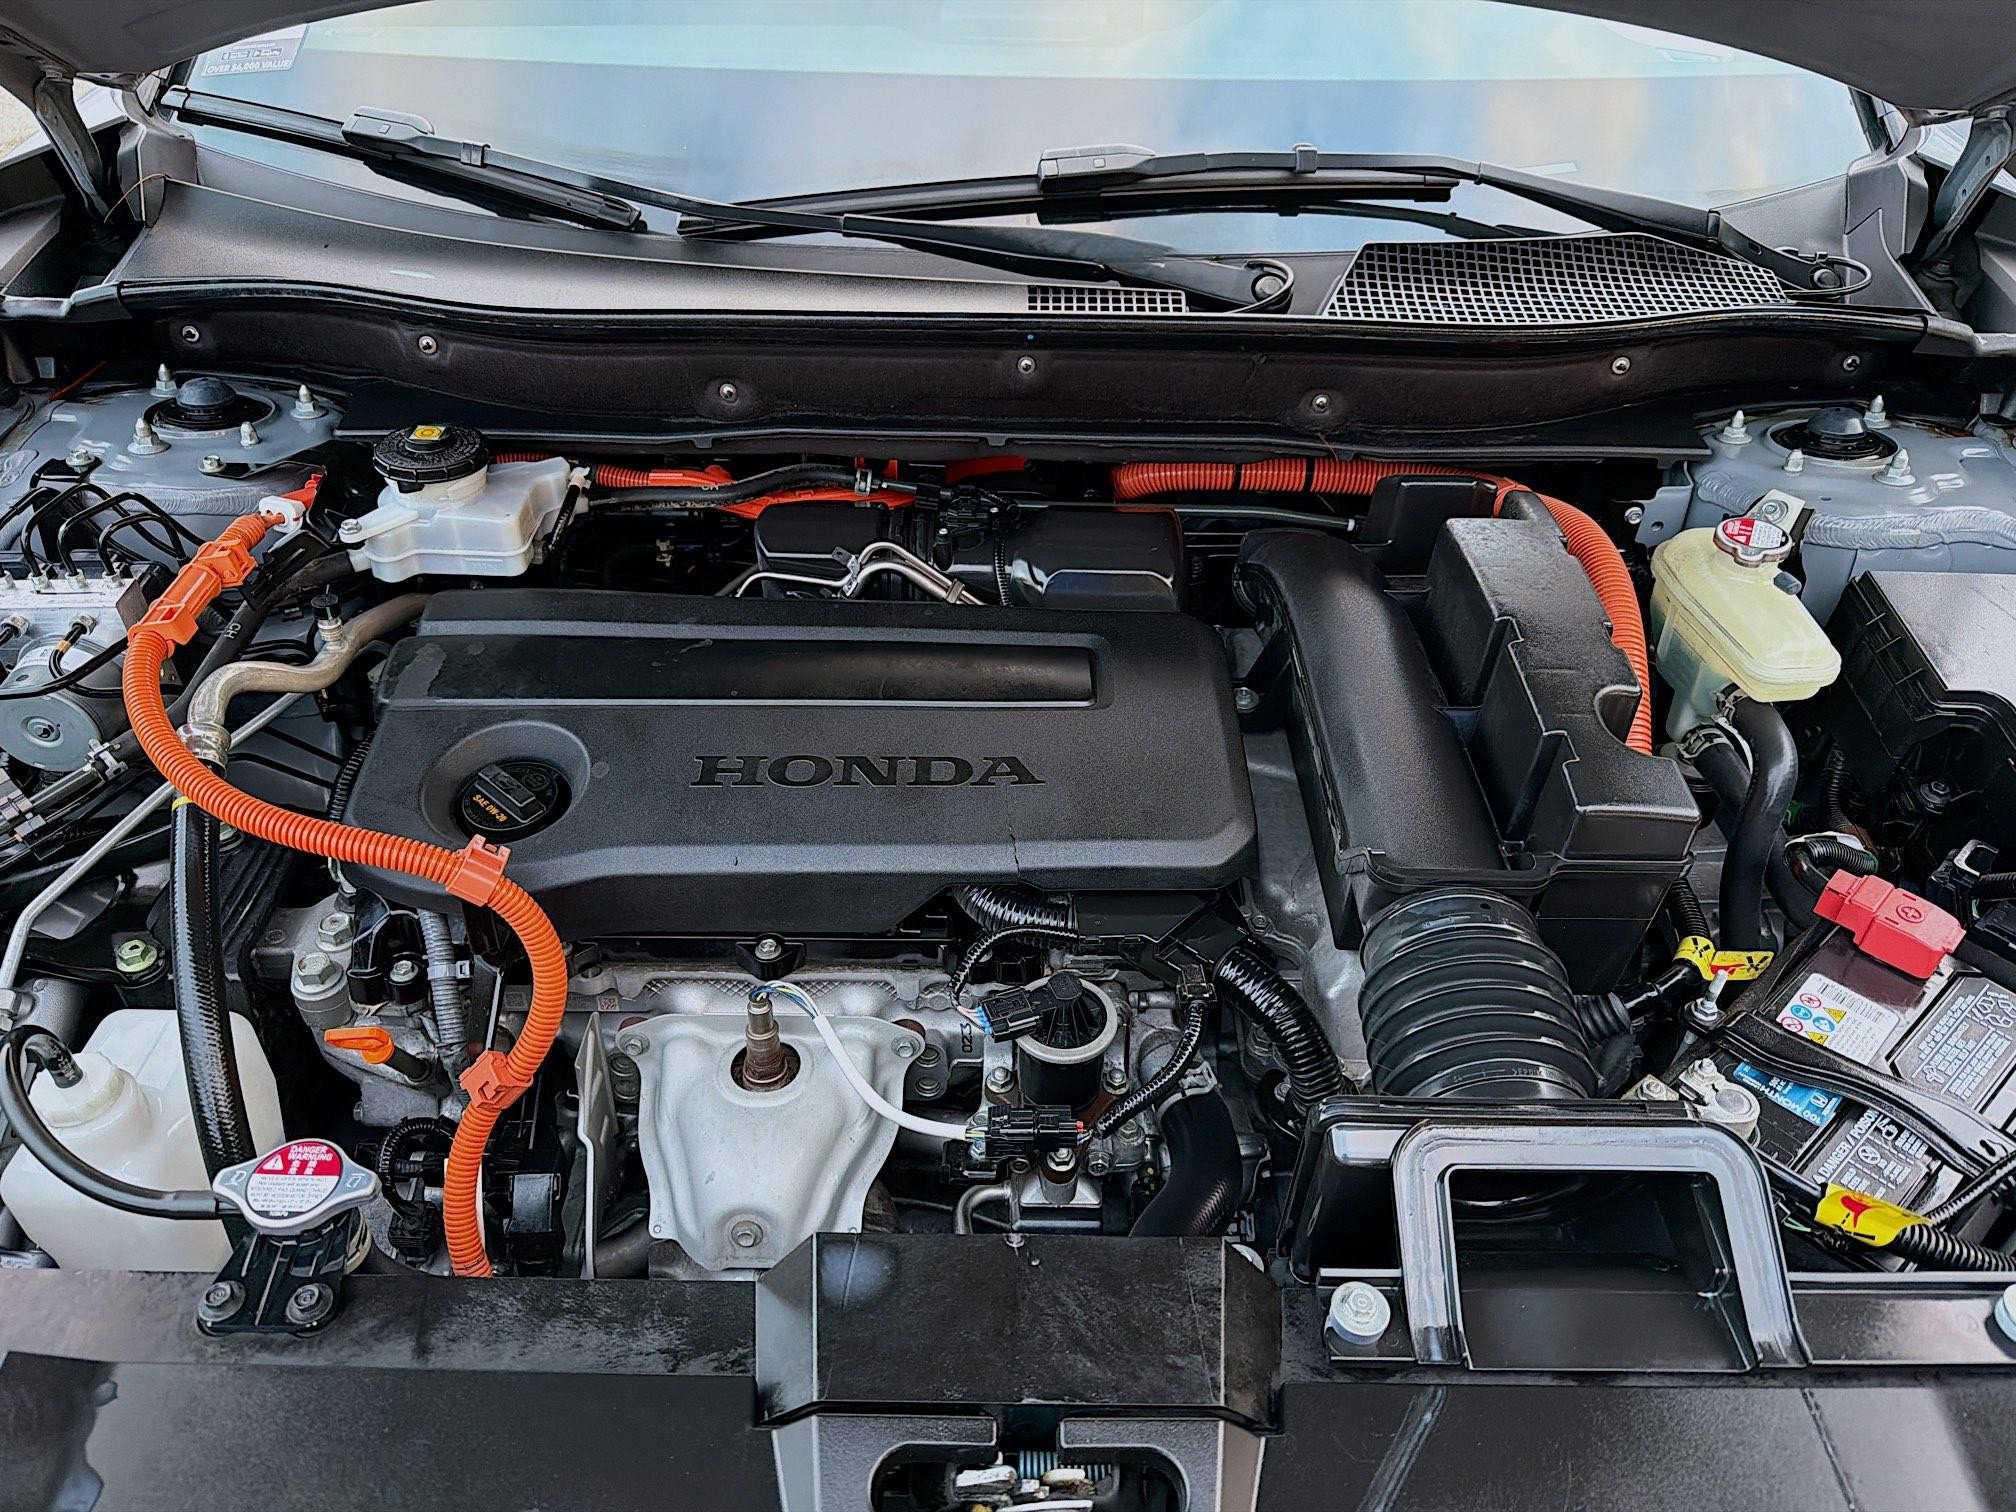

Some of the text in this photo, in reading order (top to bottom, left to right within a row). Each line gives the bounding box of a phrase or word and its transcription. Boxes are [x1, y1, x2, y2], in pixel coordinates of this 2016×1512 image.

[689, 754, 1047, 788] HONDA
[472, 794, 508, 822] SAE 0W-20
[1759, 1083, 1805, 1115] MONTH
[1802, 1110, 1822, 1124] 100
[290, 1145, 328, 1153] DANGER
[1818, 1141, 1852, 1179] DANGER
